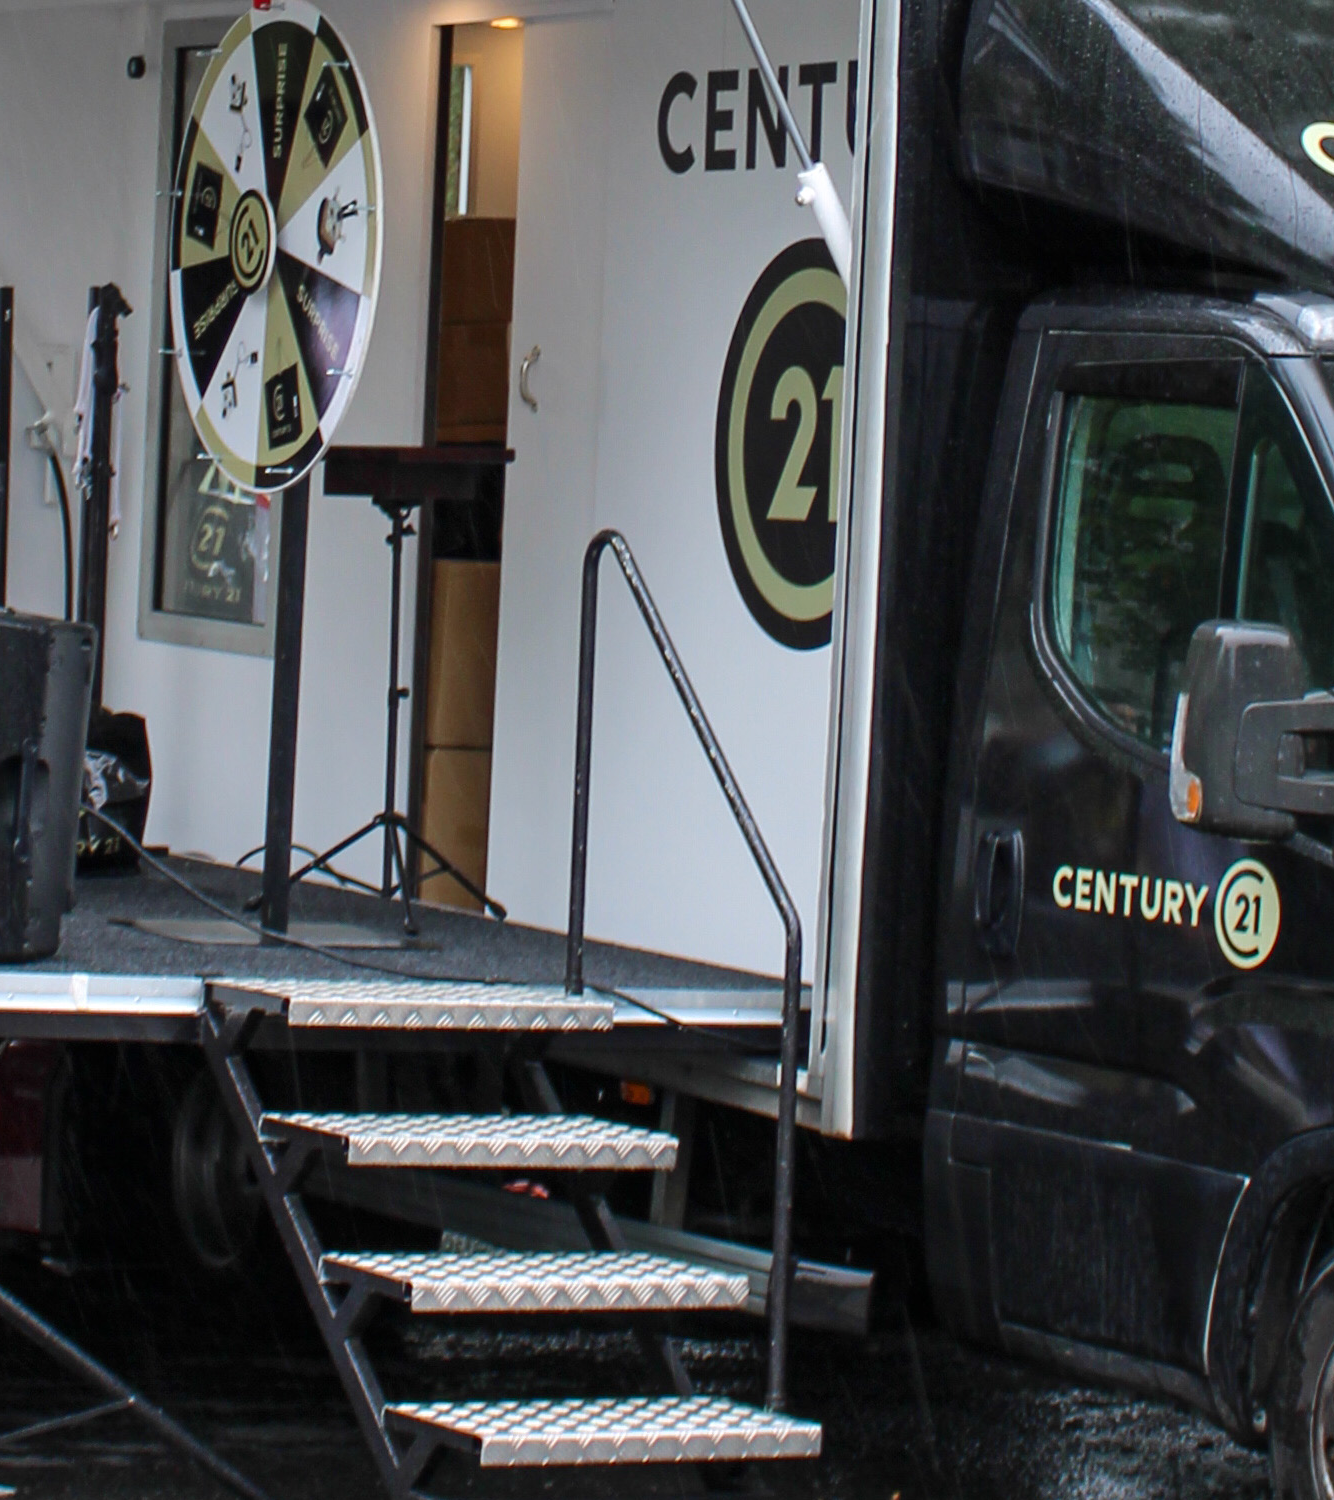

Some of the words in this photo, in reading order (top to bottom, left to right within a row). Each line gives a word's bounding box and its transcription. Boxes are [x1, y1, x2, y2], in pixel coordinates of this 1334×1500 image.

[272, 42, 289, 160] SURPRISE
[296, 283, 340, 361] SURPRISE
[767, 364, 845, 523] 21
[199, 523, 226, 555] 21
[1052, 863, 1210, 928] CENTURY
[1234, 893, 1262, 936] 21
